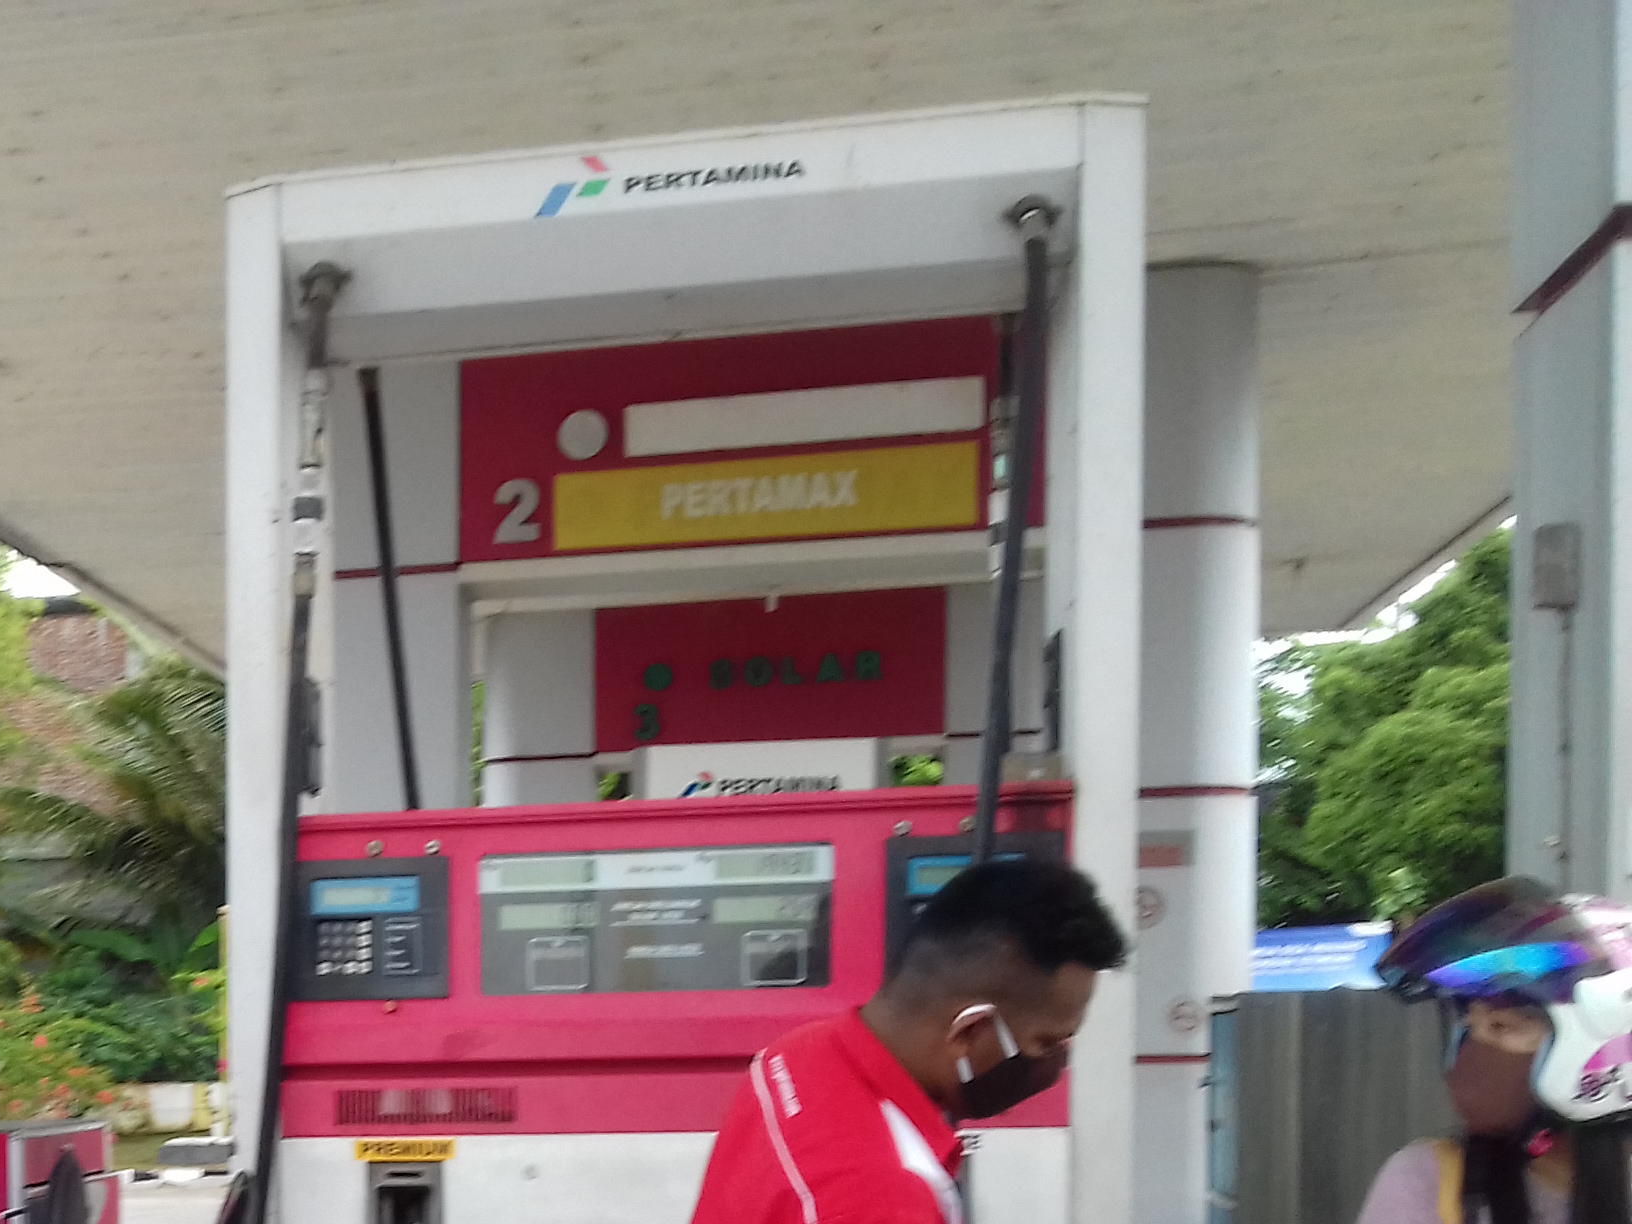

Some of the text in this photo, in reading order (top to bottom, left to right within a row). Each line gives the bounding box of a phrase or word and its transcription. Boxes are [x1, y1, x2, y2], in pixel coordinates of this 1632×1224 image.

[623, 158, 806, 194] PERTAMINA
[493, 479, 541, 545] 2
[660, 470, 857, 520] PERTAMAX
[708, 650, 883, 691] SOLAR
[633, 703, 661, 741] 3
[719, 775, 839, 797] PERTAMINA
[360, 1140, 452, 1156] PREMIUM
